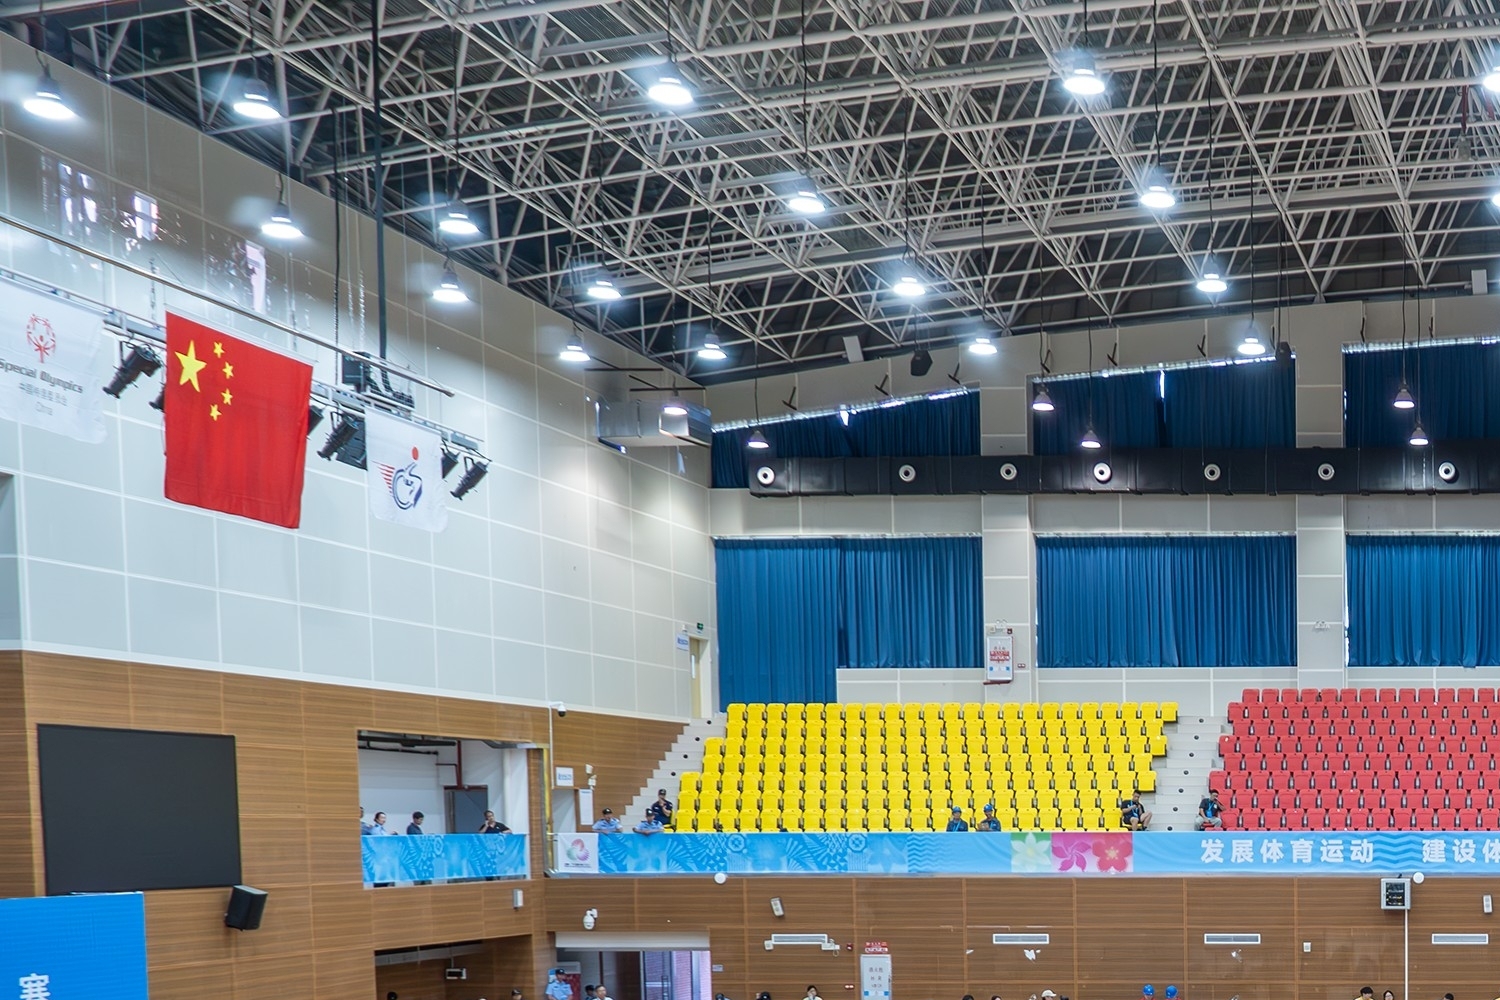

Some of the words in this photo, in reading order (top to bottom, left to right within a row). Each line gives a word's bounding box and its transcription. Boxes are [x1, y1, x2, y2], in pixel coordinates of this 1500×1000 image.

[40, 371, 83, 393] Olympics
[1200, 838, 1374, 864] 发展体育运动
